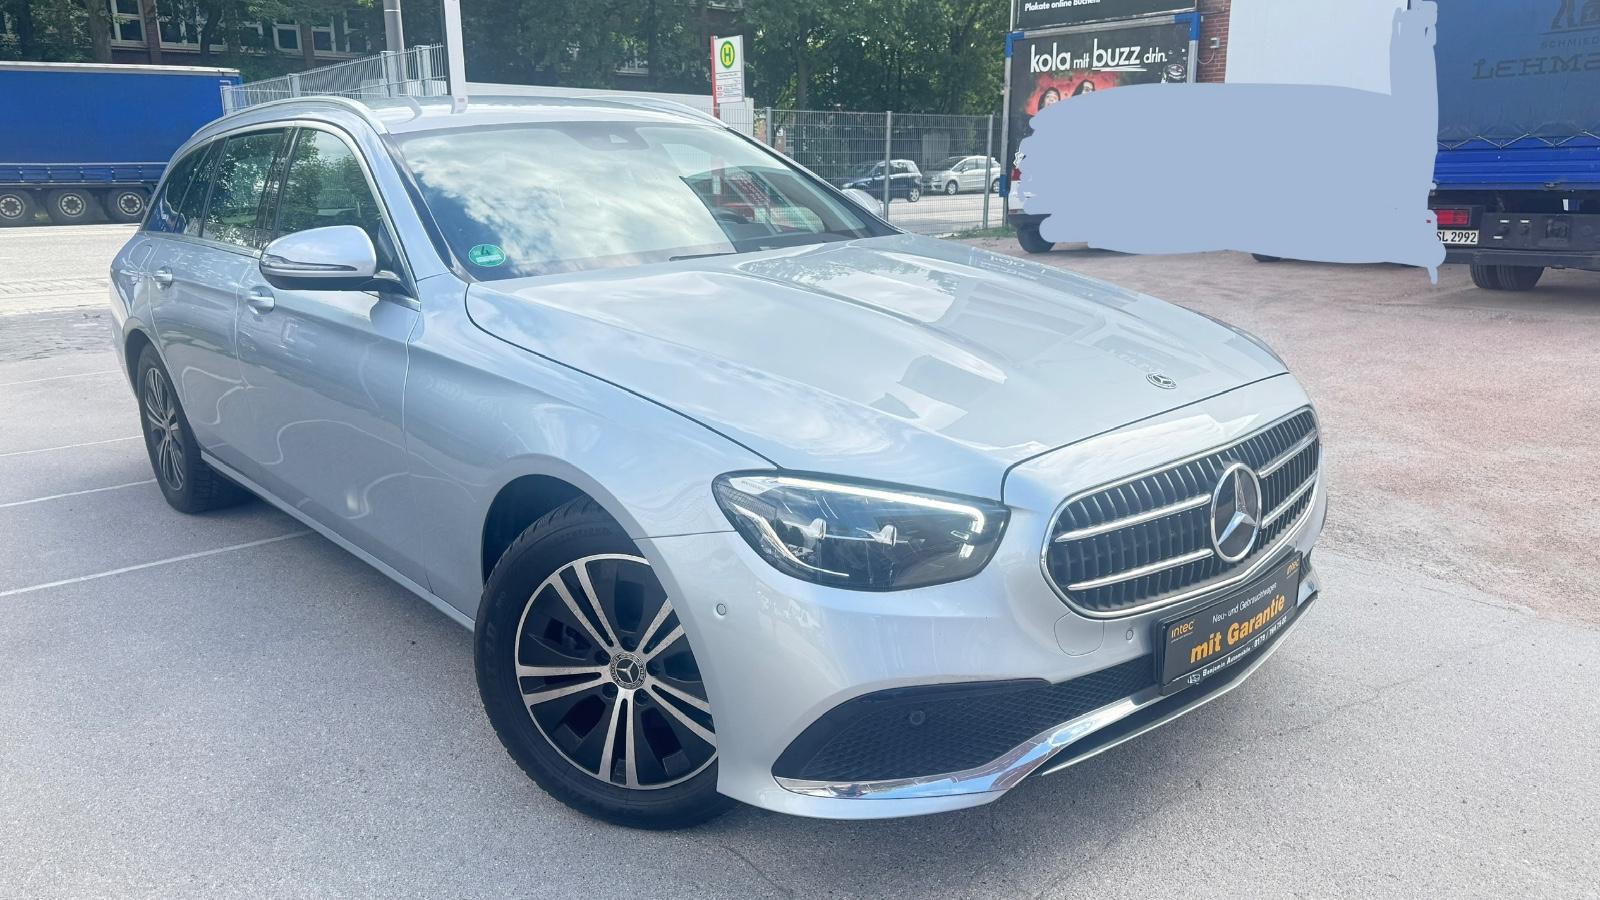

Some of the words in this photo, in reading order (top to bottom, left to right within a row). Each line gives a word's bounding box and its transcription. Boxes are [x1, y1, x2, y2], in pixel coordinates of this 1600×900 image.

[1024, 2, 1050, 12] Plakate
[1051, 0, 1072, 9] online
[723, 47, 732, 63] H
[1030, 42, 1071, 73] kola
[1073, 53, 1090, 69] mit
[1092, 38, 1141, 68] buzz
[1143, 47, 1168, 64] drin.
[1451, 231, 1477, 243] 2992
[1227, 602, 1239, 617] und
[1171, 620, 1195, 638] intec
[1190, 631, 1222, 664] mit
[1227, 594, 1285, 645] Garantie
